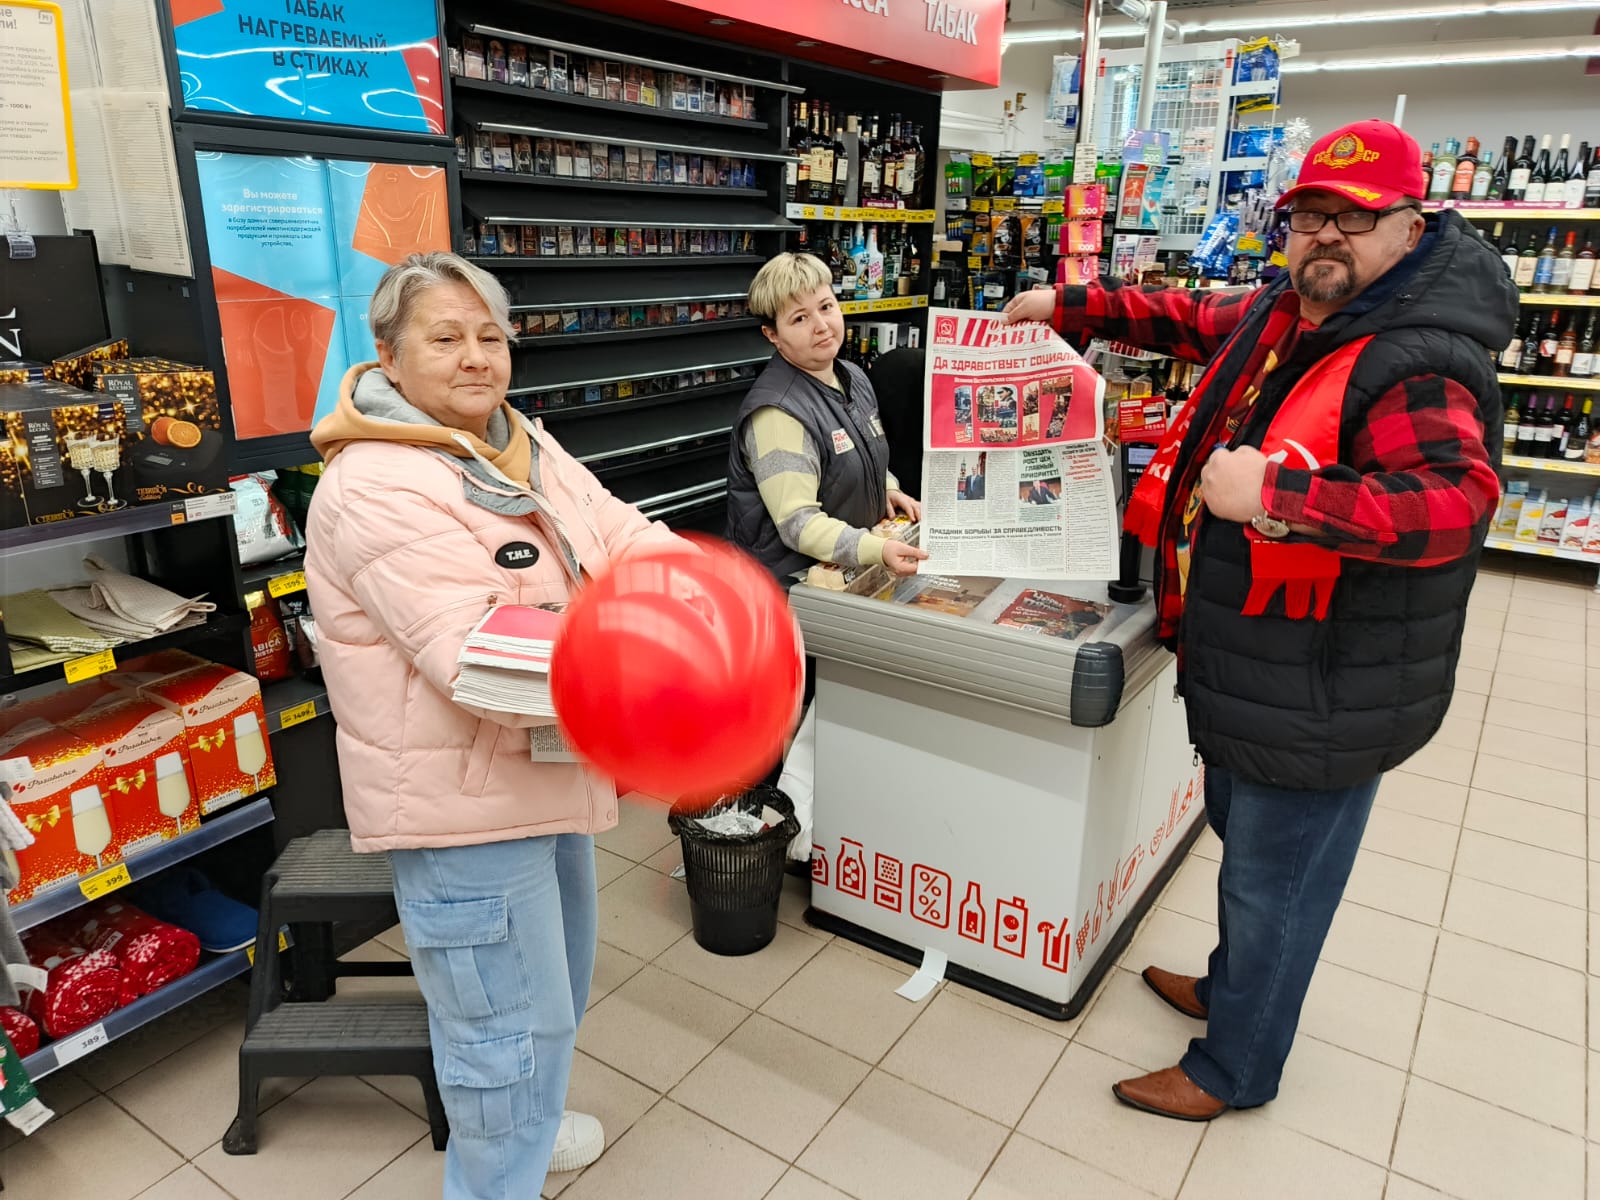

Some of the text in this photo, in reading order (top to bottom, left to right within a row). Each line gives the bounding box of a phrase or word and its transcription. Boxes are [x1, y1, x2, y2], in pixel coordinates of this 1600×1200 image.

[925, 0, 979, 45] ТАБАК
[238, 14, 388, 56] НАГРЕВАЕМЫЙ
[290, 51, 369, 78] СТИКАХ
[243, 188, 298, 201] Вы можете
[951, 358, 1027, 371] ЗДРАВСТВУЕТ
[105, 875, 122, 887] 399
[82, 1035, 99, 1048] 389
